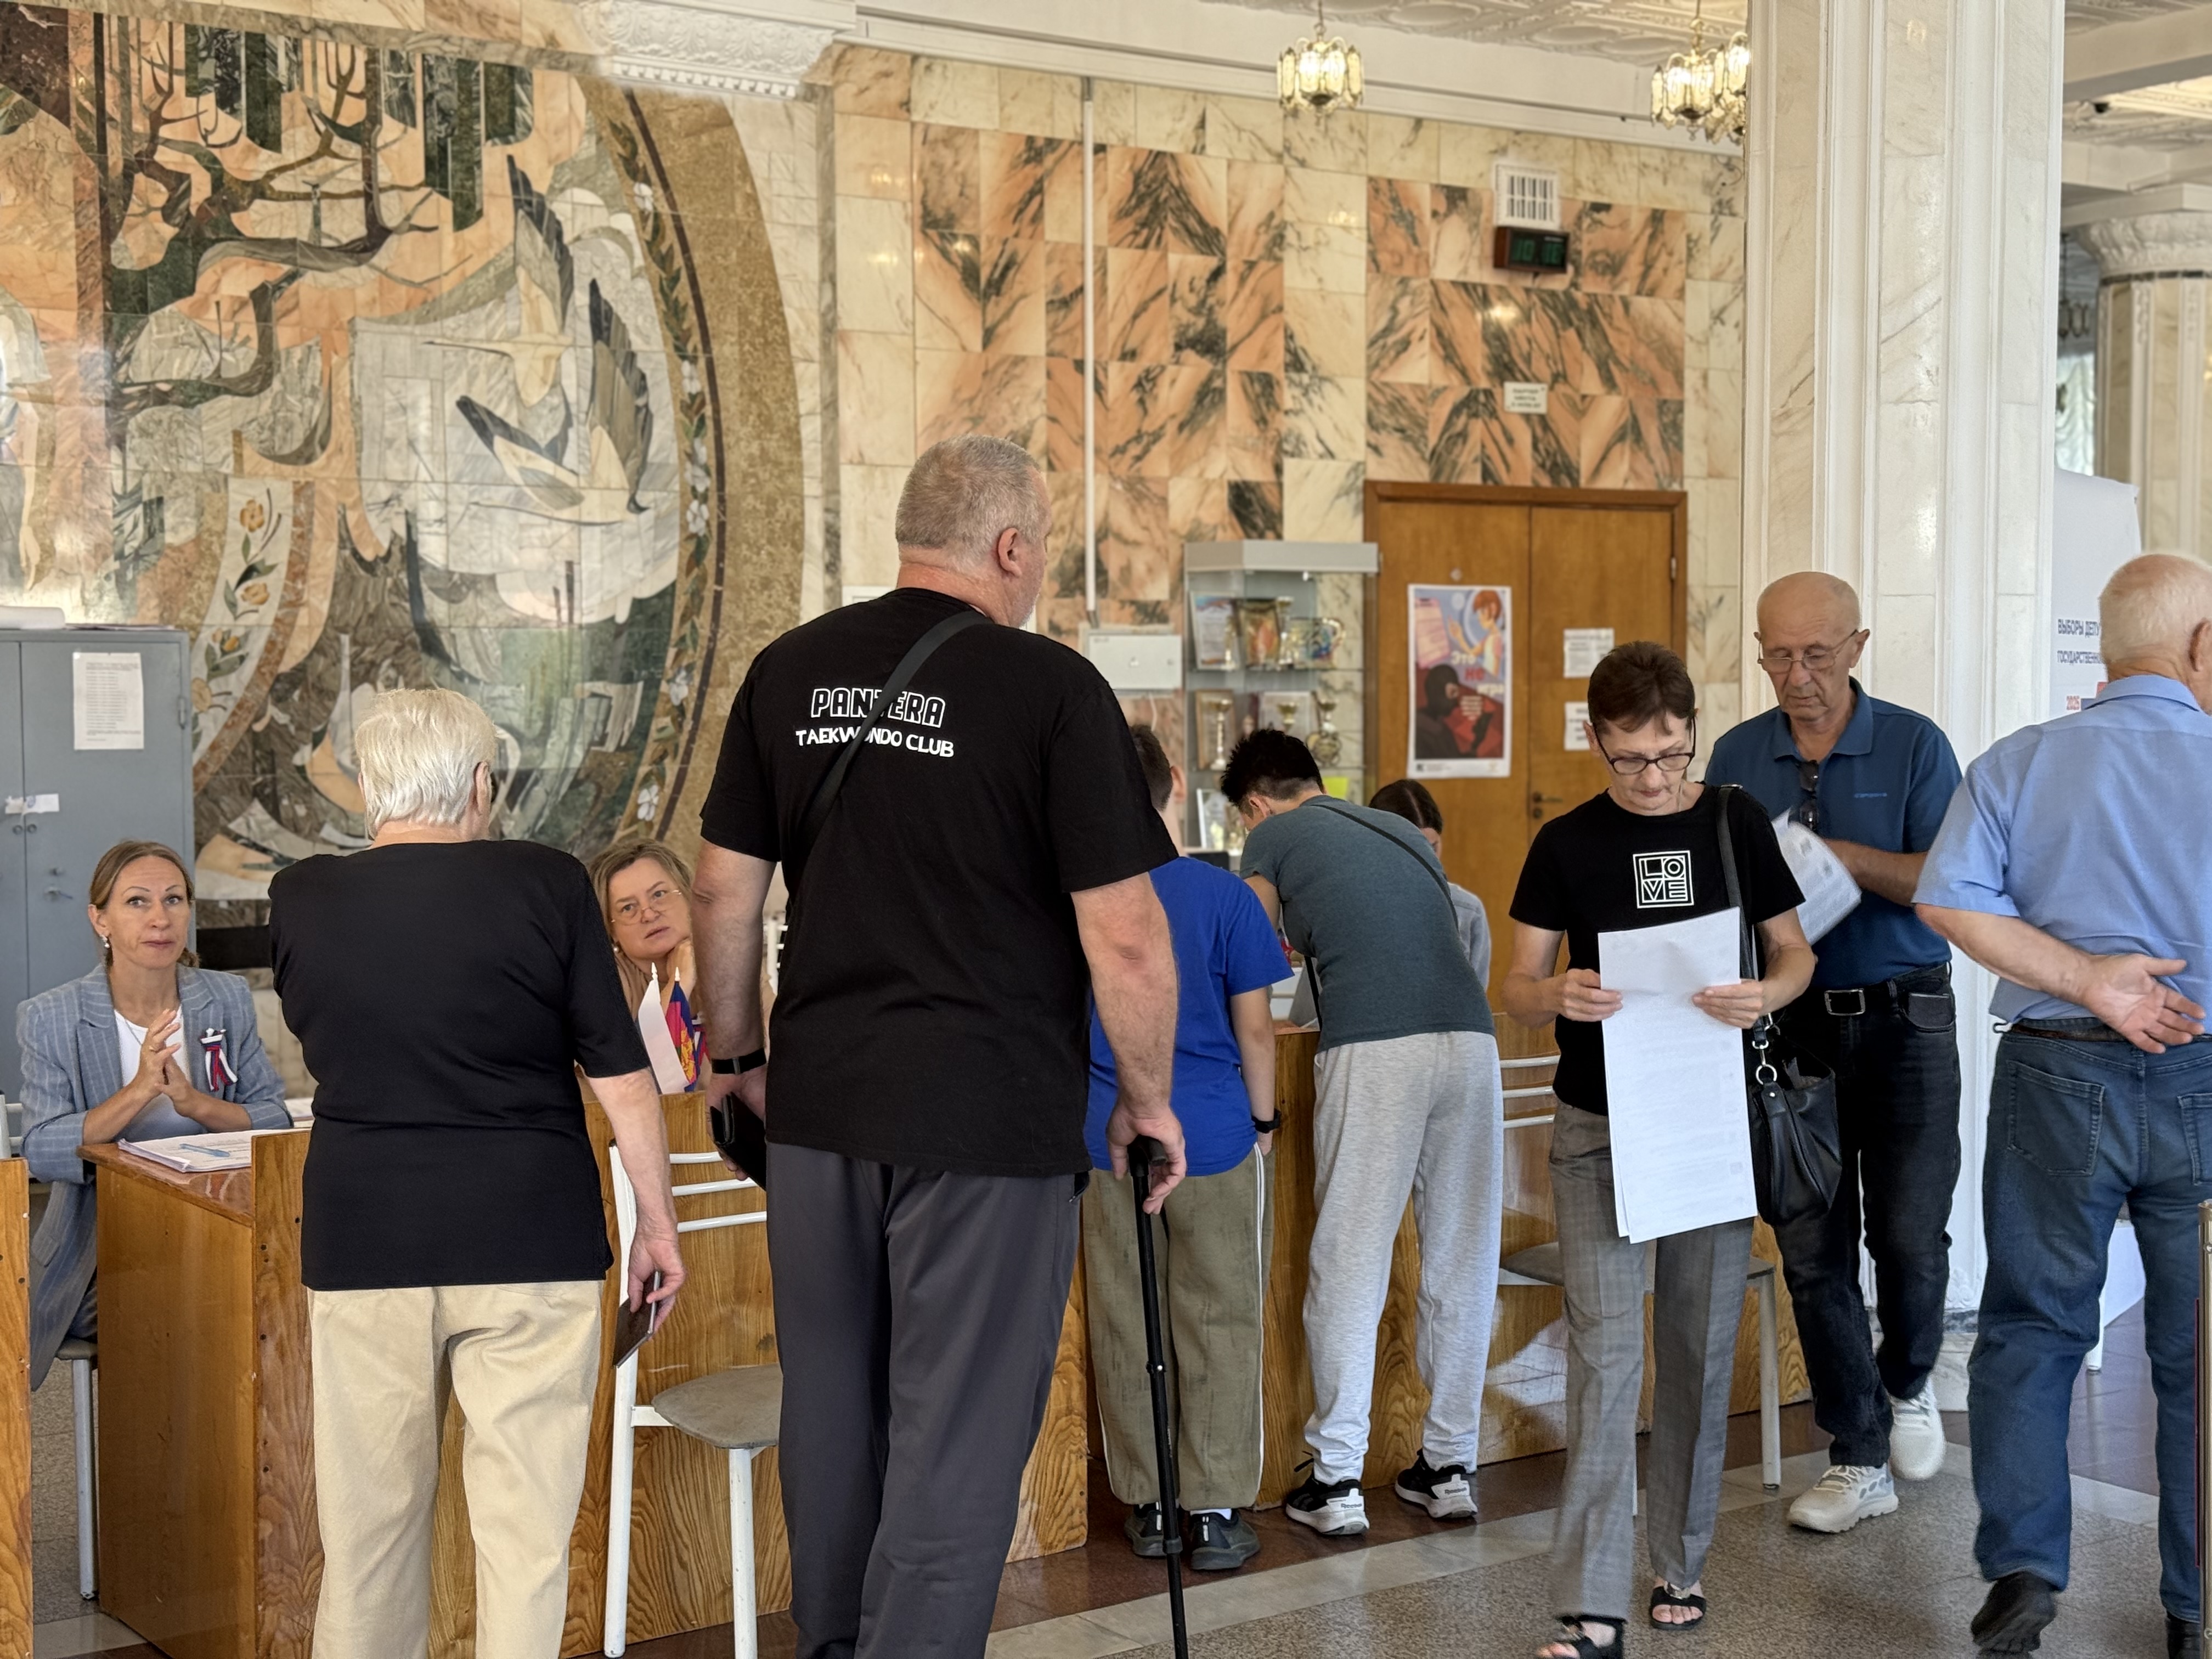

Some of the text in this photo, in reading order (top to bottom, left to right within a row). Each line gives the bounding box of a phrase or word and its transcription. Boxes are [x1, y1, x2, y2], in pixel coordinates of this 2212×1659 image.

[2058, 619, 2084, 635] ВЫБОРЫ
[811, 687, 946, 729] PANERA
[795, 726, 955, 758] TAEKWNDO CLUB
